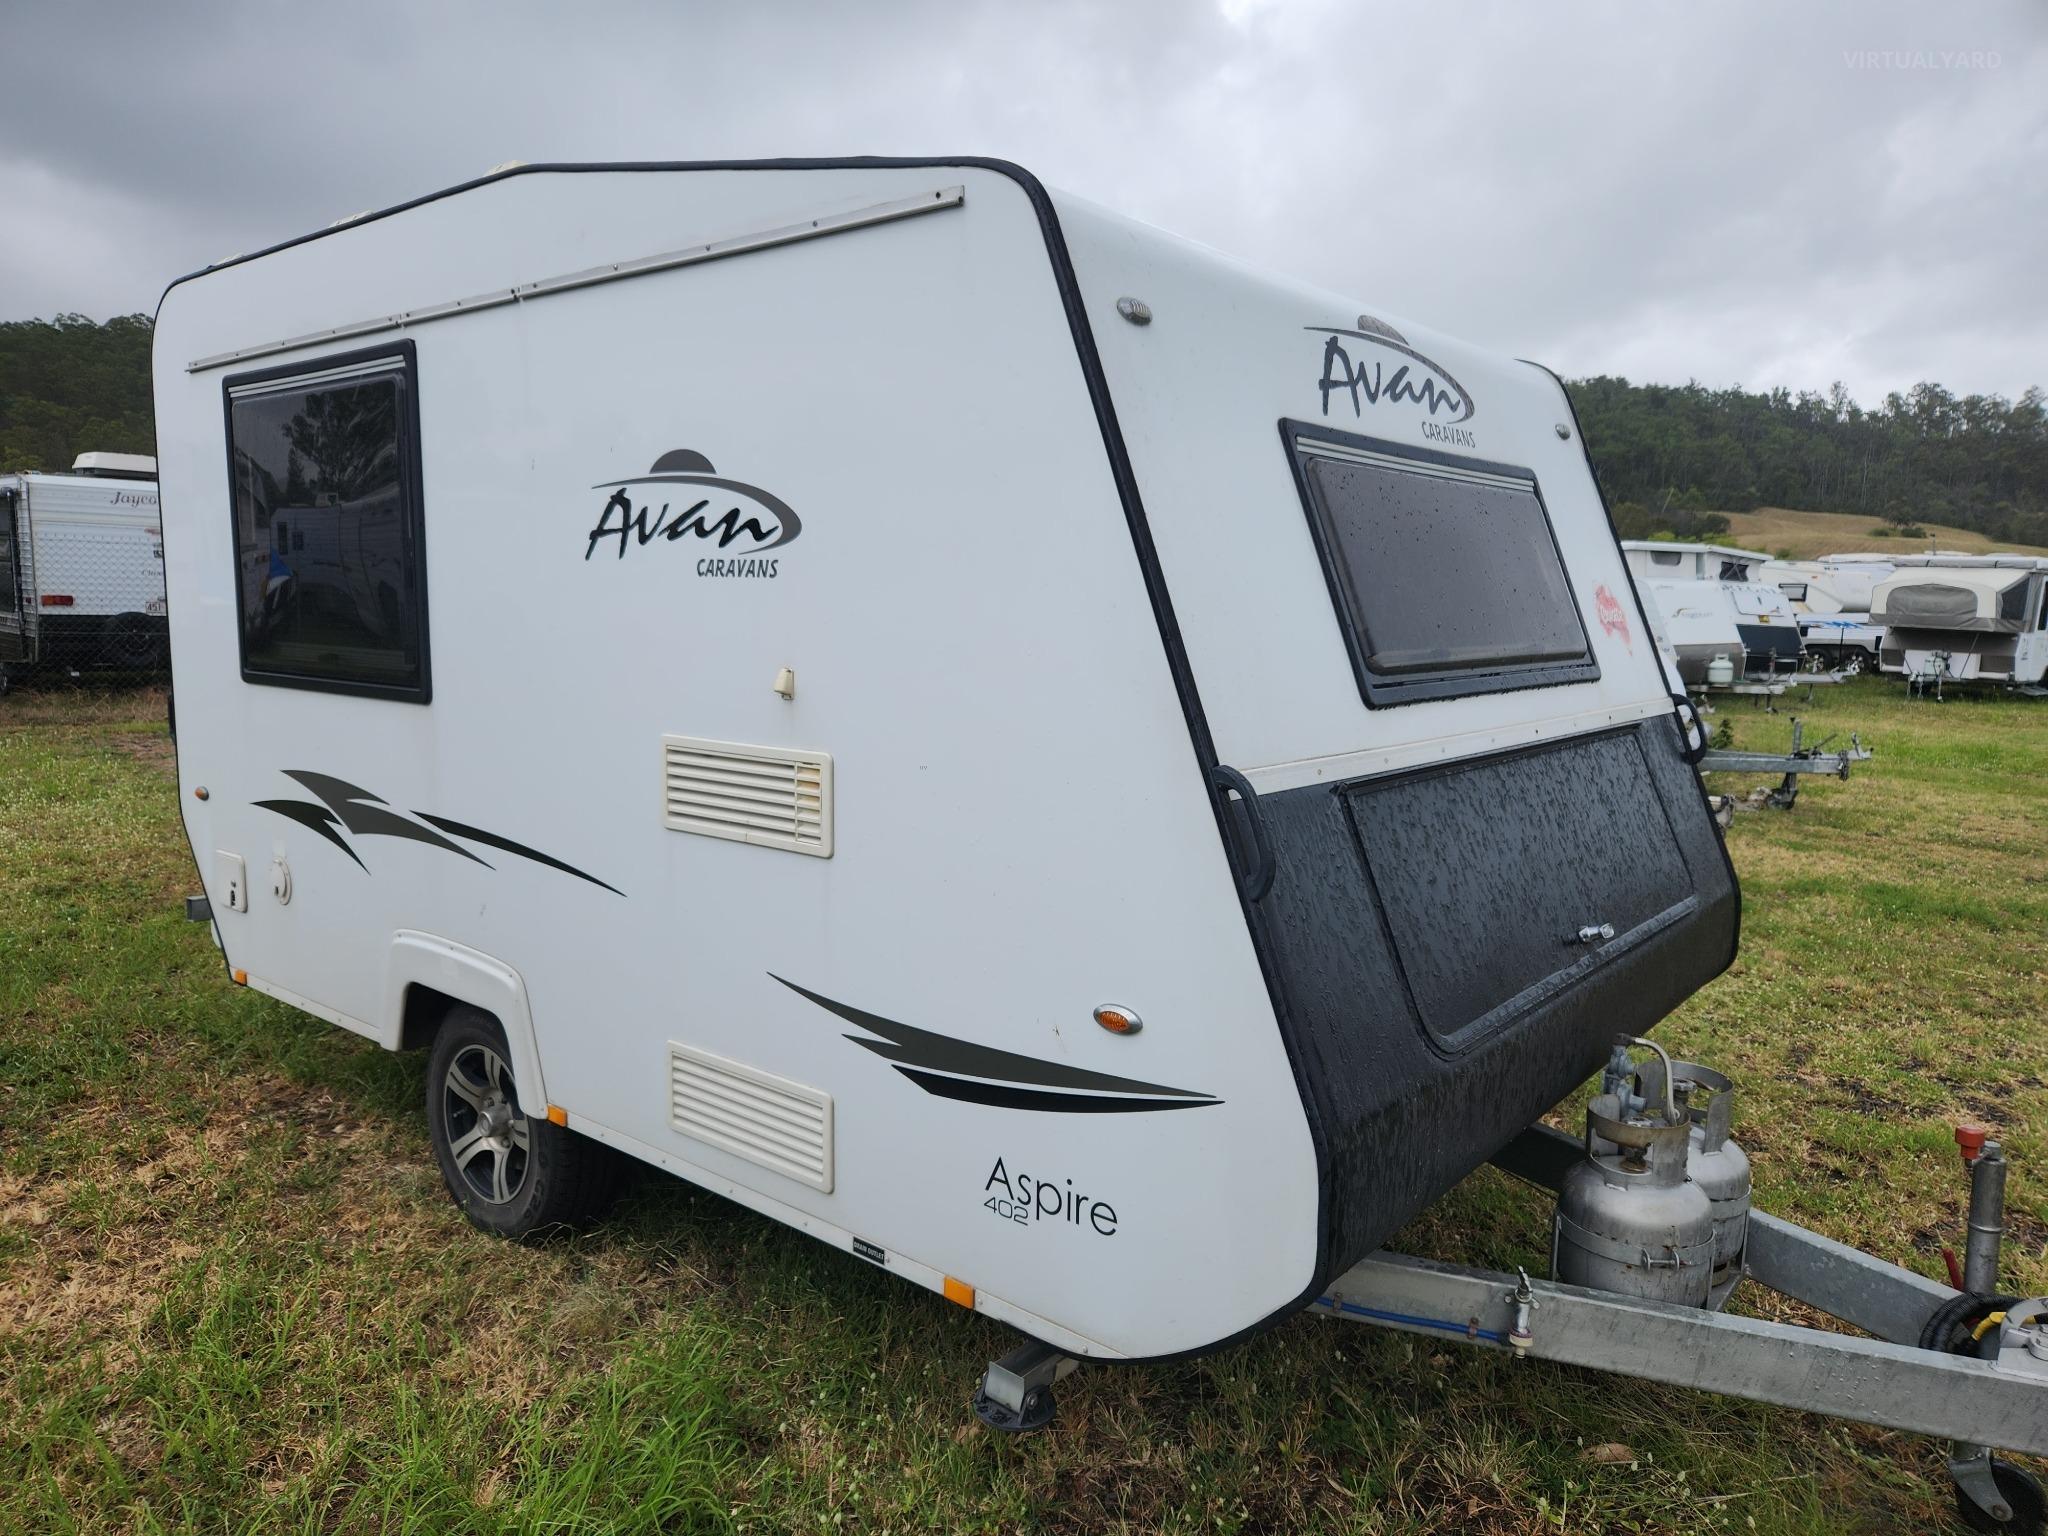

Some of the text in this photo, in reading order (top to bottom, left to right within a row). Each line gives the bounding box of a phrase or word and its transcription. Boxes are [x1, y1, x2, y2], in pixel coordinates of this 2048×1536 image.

[1318, 335, 1461, 419] Avan
[1421, 421, 1476, 449] CARAVANS
[585, 487, 780, 561] Avan
[696, 558, 779, 578] CARAVANS
[983, 1196, 1029, 1226] 402
[985, 1155, 1118, 1236] Aspire
